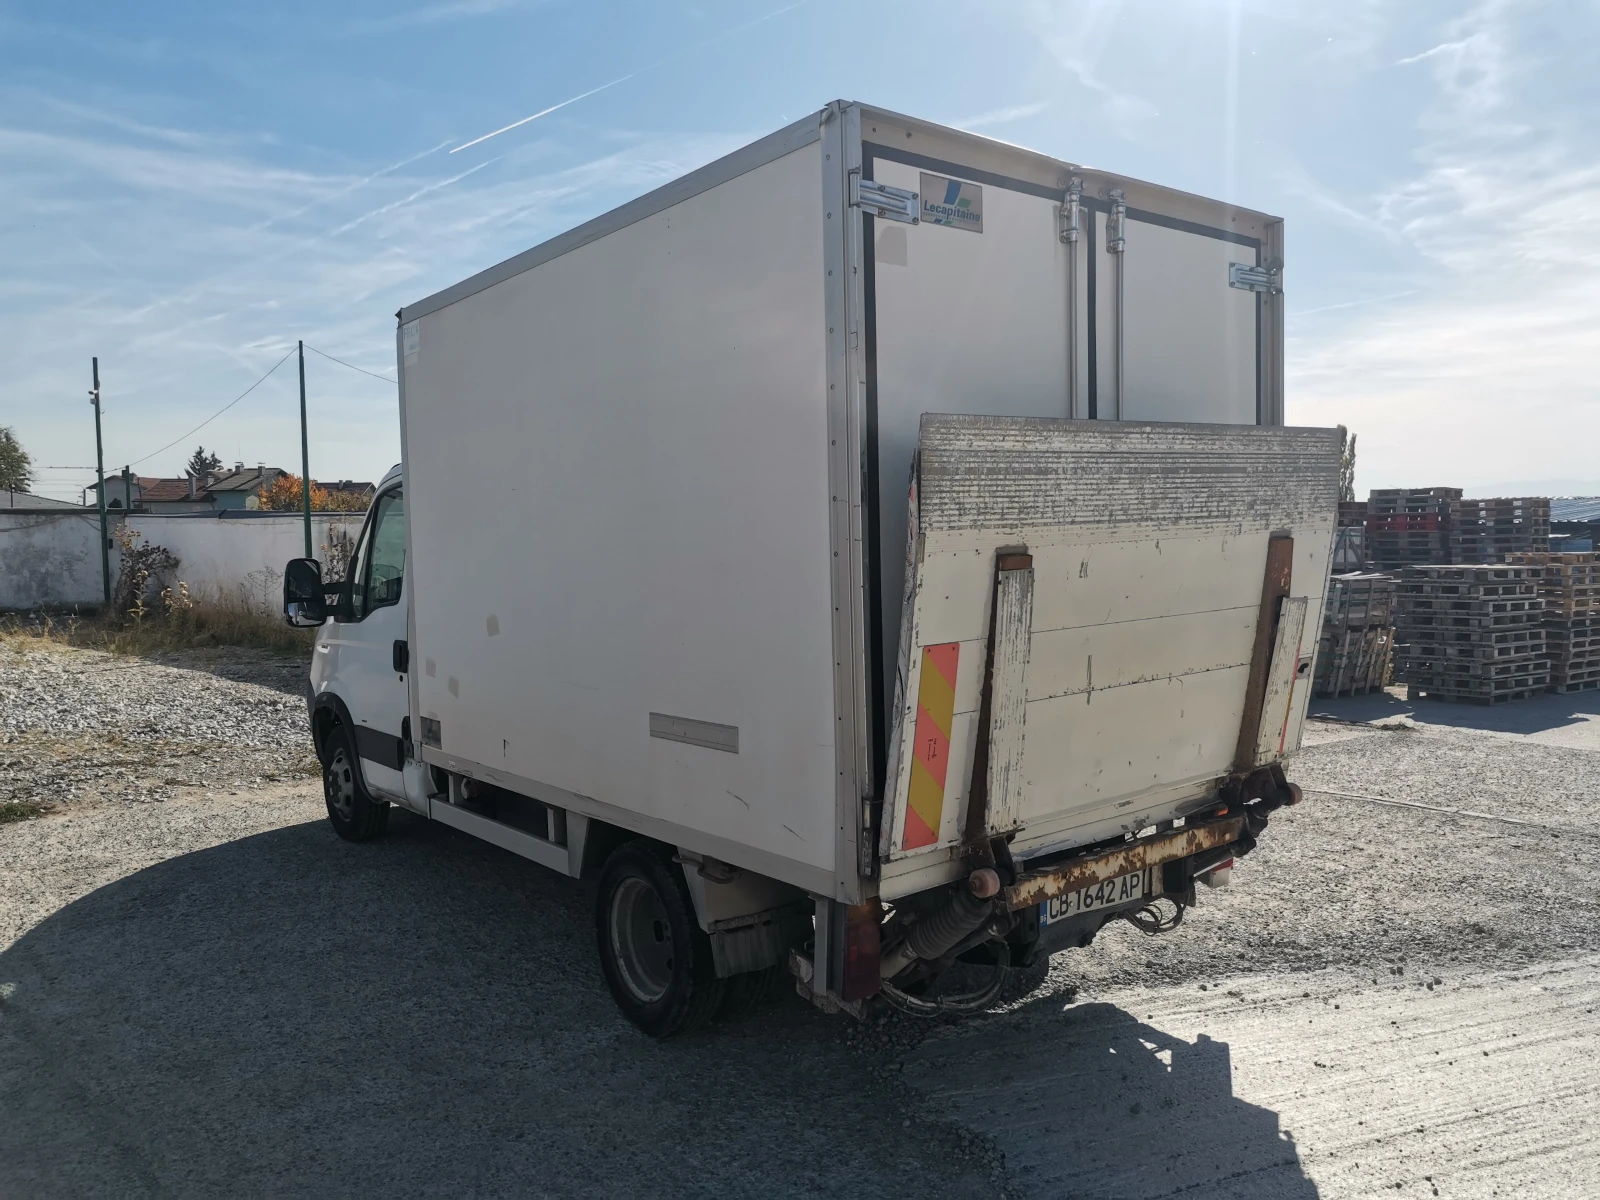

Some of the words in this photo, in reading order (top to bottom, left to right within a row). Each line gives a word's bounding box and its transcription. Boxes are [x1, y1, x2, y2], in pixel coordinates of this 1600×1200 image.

[923, 199, 981, 222] Lecapitaine
[1049, 894, 1069, 919] CB
[1075, 880, 1115, 910] 1642
[1120, 873, 1140, 901] AP
